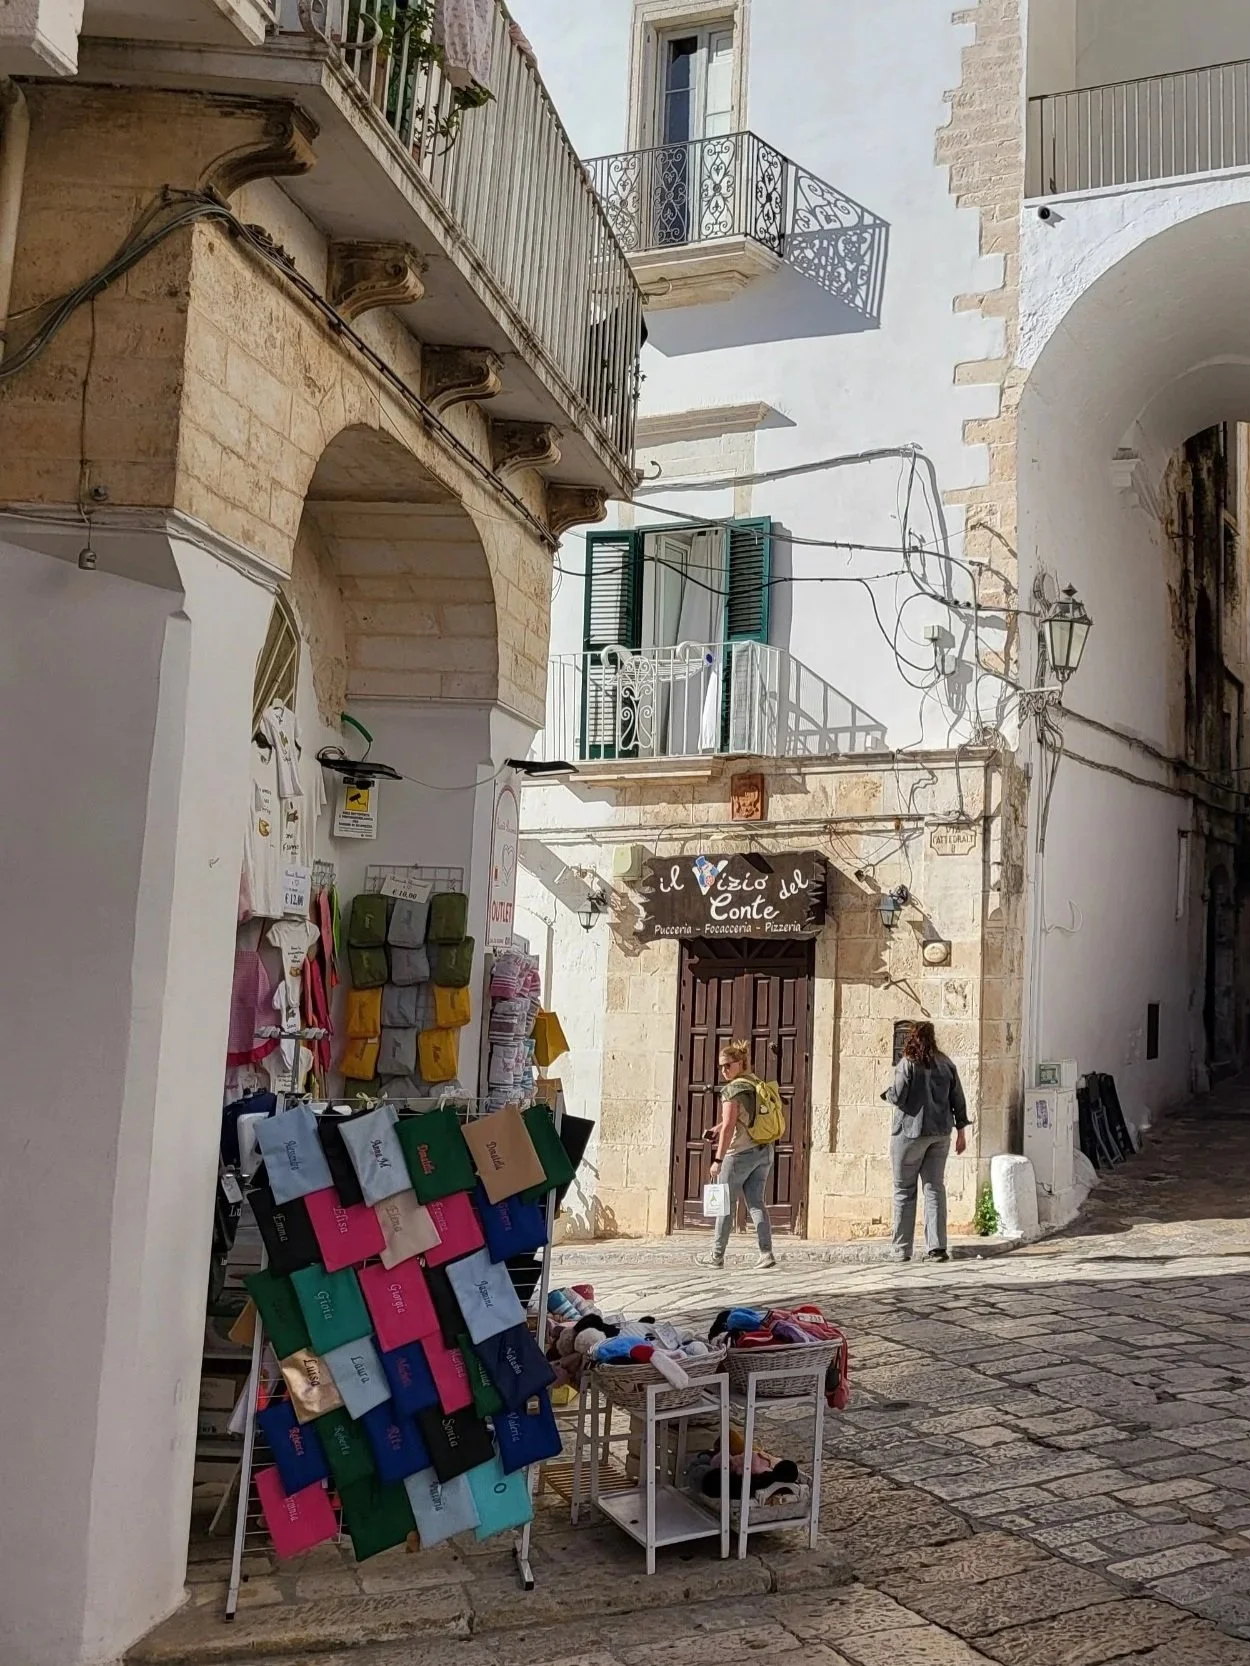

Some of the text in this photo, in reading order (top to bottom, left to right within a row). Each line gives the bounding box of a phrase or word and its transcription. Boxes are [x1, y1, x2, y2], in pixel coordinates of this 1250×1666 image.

[659, 859, 809, 900] il Vizio del
[491, 901, 513, 924] OUTLET
[710, 893, 780, 921] Conte
[654, 924, 692, 935] Pucceria
[704, 923, 752, 934] Focacceria
[765, 922, 801, 933] Pizzeria
[272, 1213, 288, 1242] Emma
[333, 1204, 349, 1234] Elisa
[385, 1204, 403, 1233] Elena
[315, 1290, 335, 1320] Gioia
[388, 1283, 408, 1314] Giorgia
[474, 1280, 495, 1309] Jasmine
[303, 1358, 321, 1387] Luisa
[351, 1356, 370, 1384] Laura
[387, 1424, 403, 1450] Rita
[441, 1418, 462, 1448] Sonia
[506, 1411, 521, 1443] Valeria
